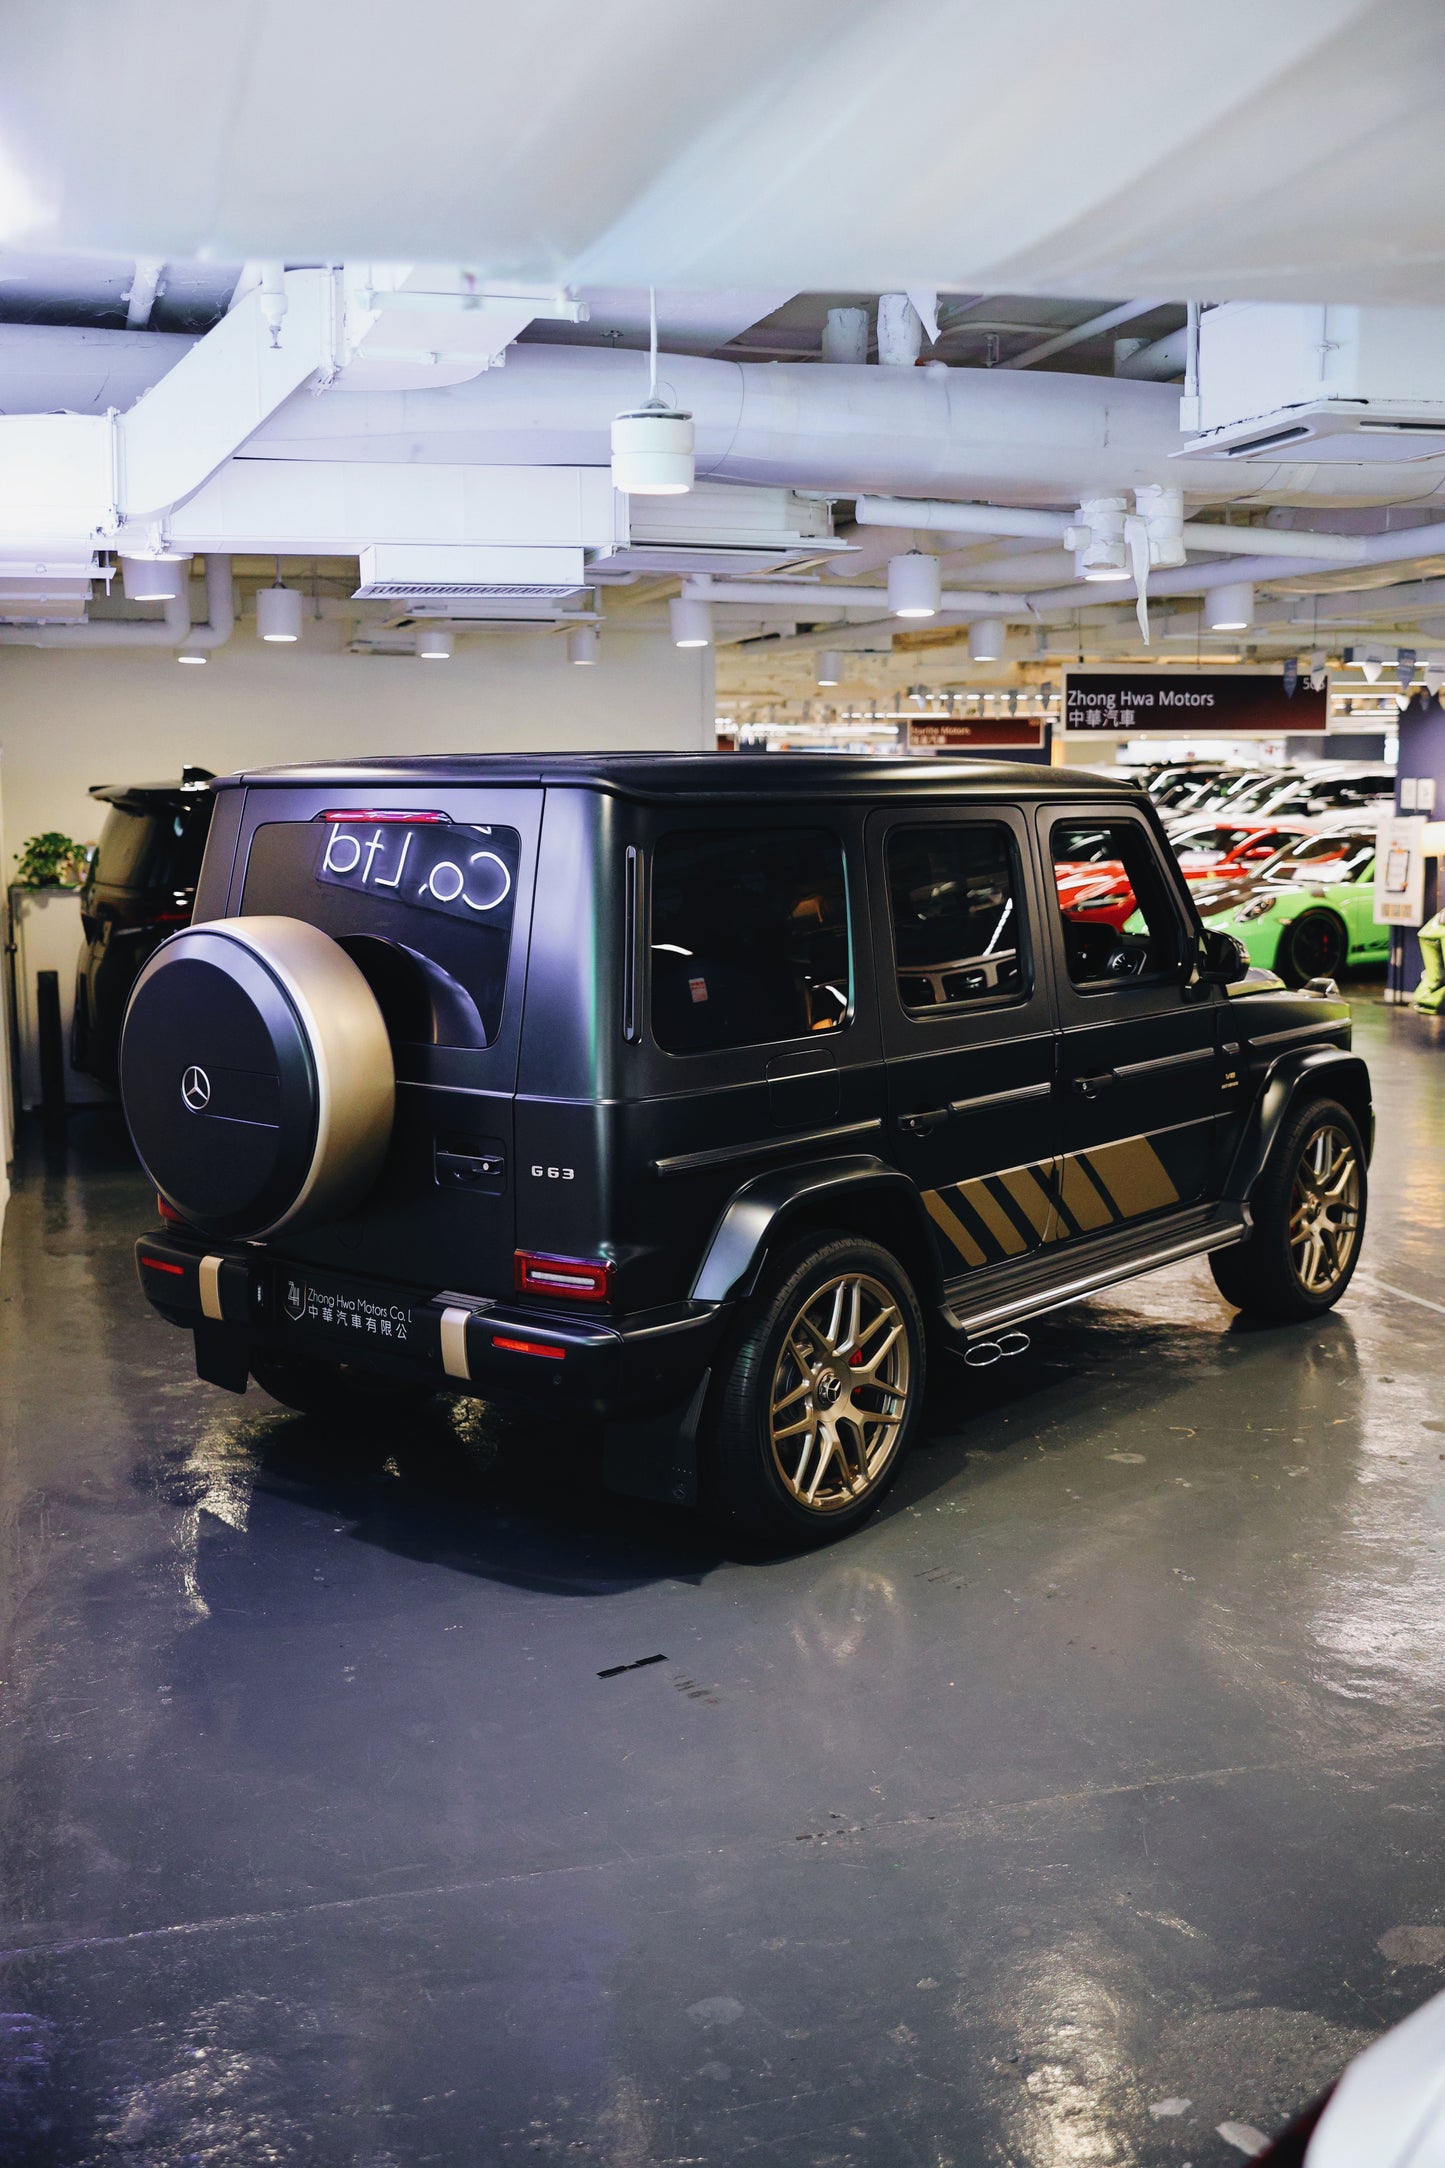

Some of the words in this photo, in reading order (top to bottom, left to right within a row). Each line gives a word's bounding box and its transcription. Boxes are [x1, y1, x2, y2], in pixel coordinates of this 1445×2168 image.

[1067, 690, 1116, 709] Zhong
[1120, 691, 1155, 706] Hwa
[1158, 690, 1215, 706] Motors
[1069, 708, 1136, 728] 中華汽車
[307, 1287, 335, 1308] Zhong
[336, 1294, 355, 1311] Hwa
[357, 1298, 387, 1318] Motors
[308, 1304, 408, 1340] 中華汽車有限公
